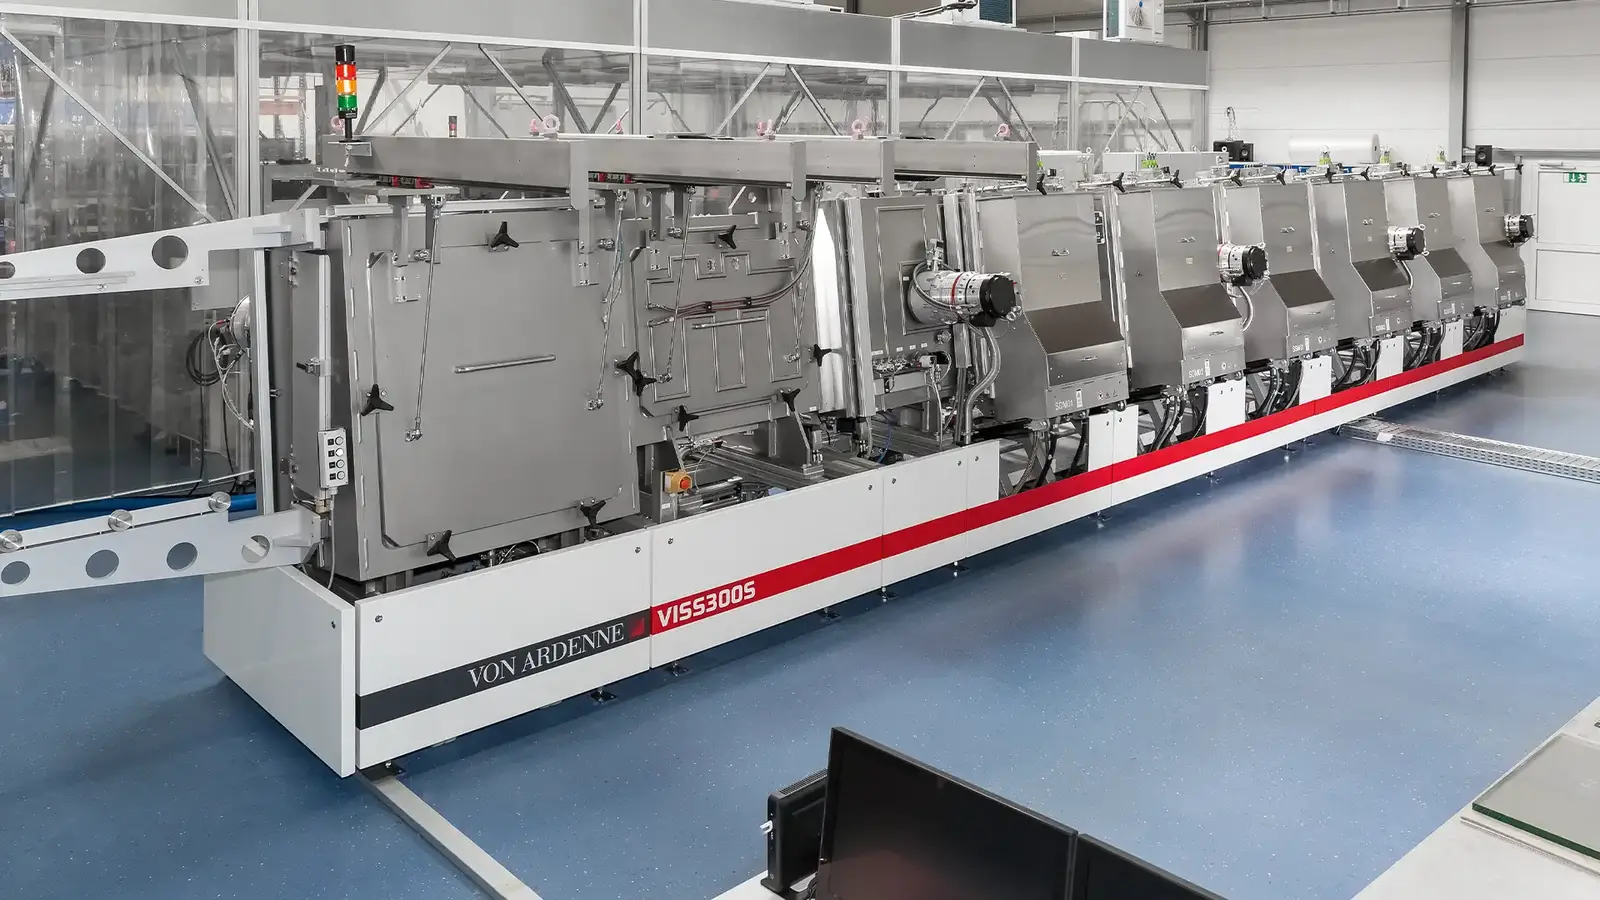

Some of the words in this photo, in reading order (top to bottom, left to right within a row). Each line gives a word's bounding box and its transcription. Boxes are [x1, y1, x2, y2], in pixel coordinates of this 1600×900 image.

[658, 580, 757, 628] VISS300S
[468, 655, 516, 688] VON
[521, 622, 625, 672] ARDENNE
